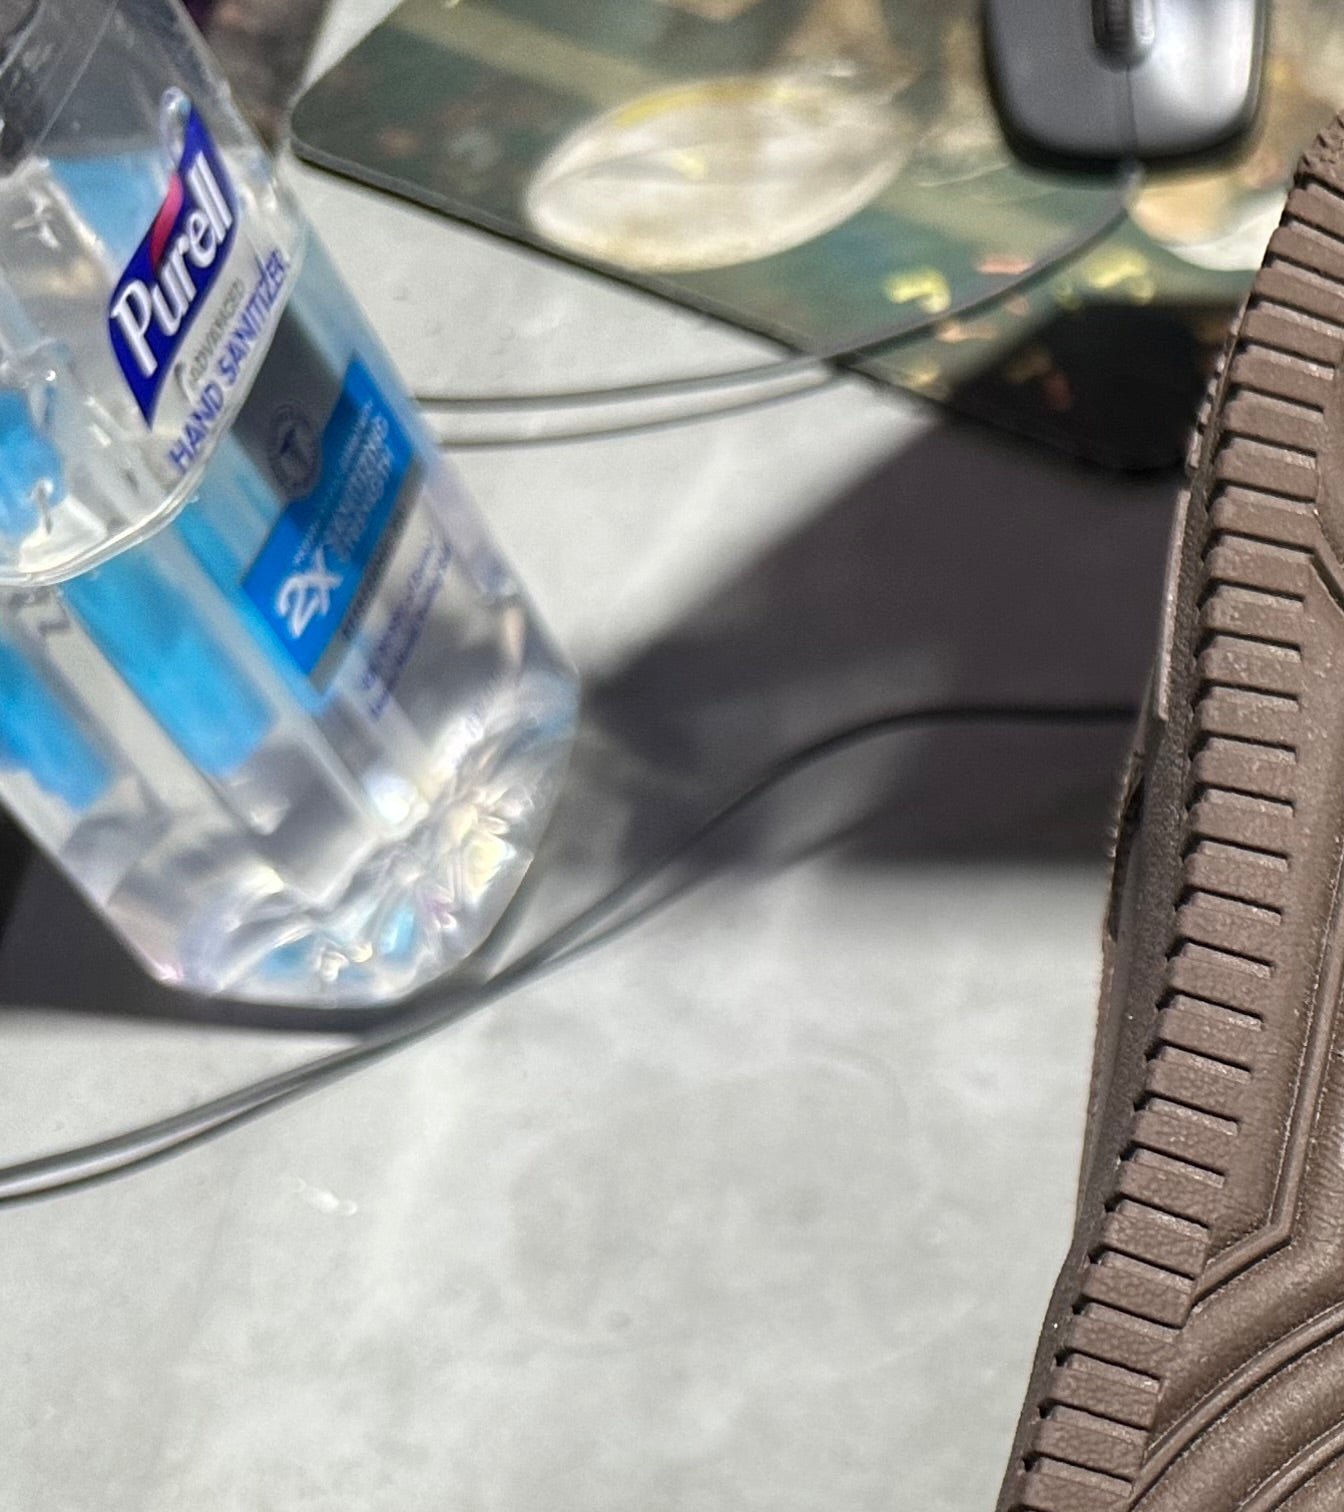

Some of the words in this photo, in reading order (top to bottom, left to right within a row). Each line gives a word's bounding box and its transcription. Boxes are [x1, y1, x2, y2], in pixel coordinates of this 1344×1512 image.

[110, 150, 232, 378] Purell
[167, 381, 225, 476] HAND
[218, 248, 288, 388] SANITIZER
[275, 545, 343, 639] 2X
